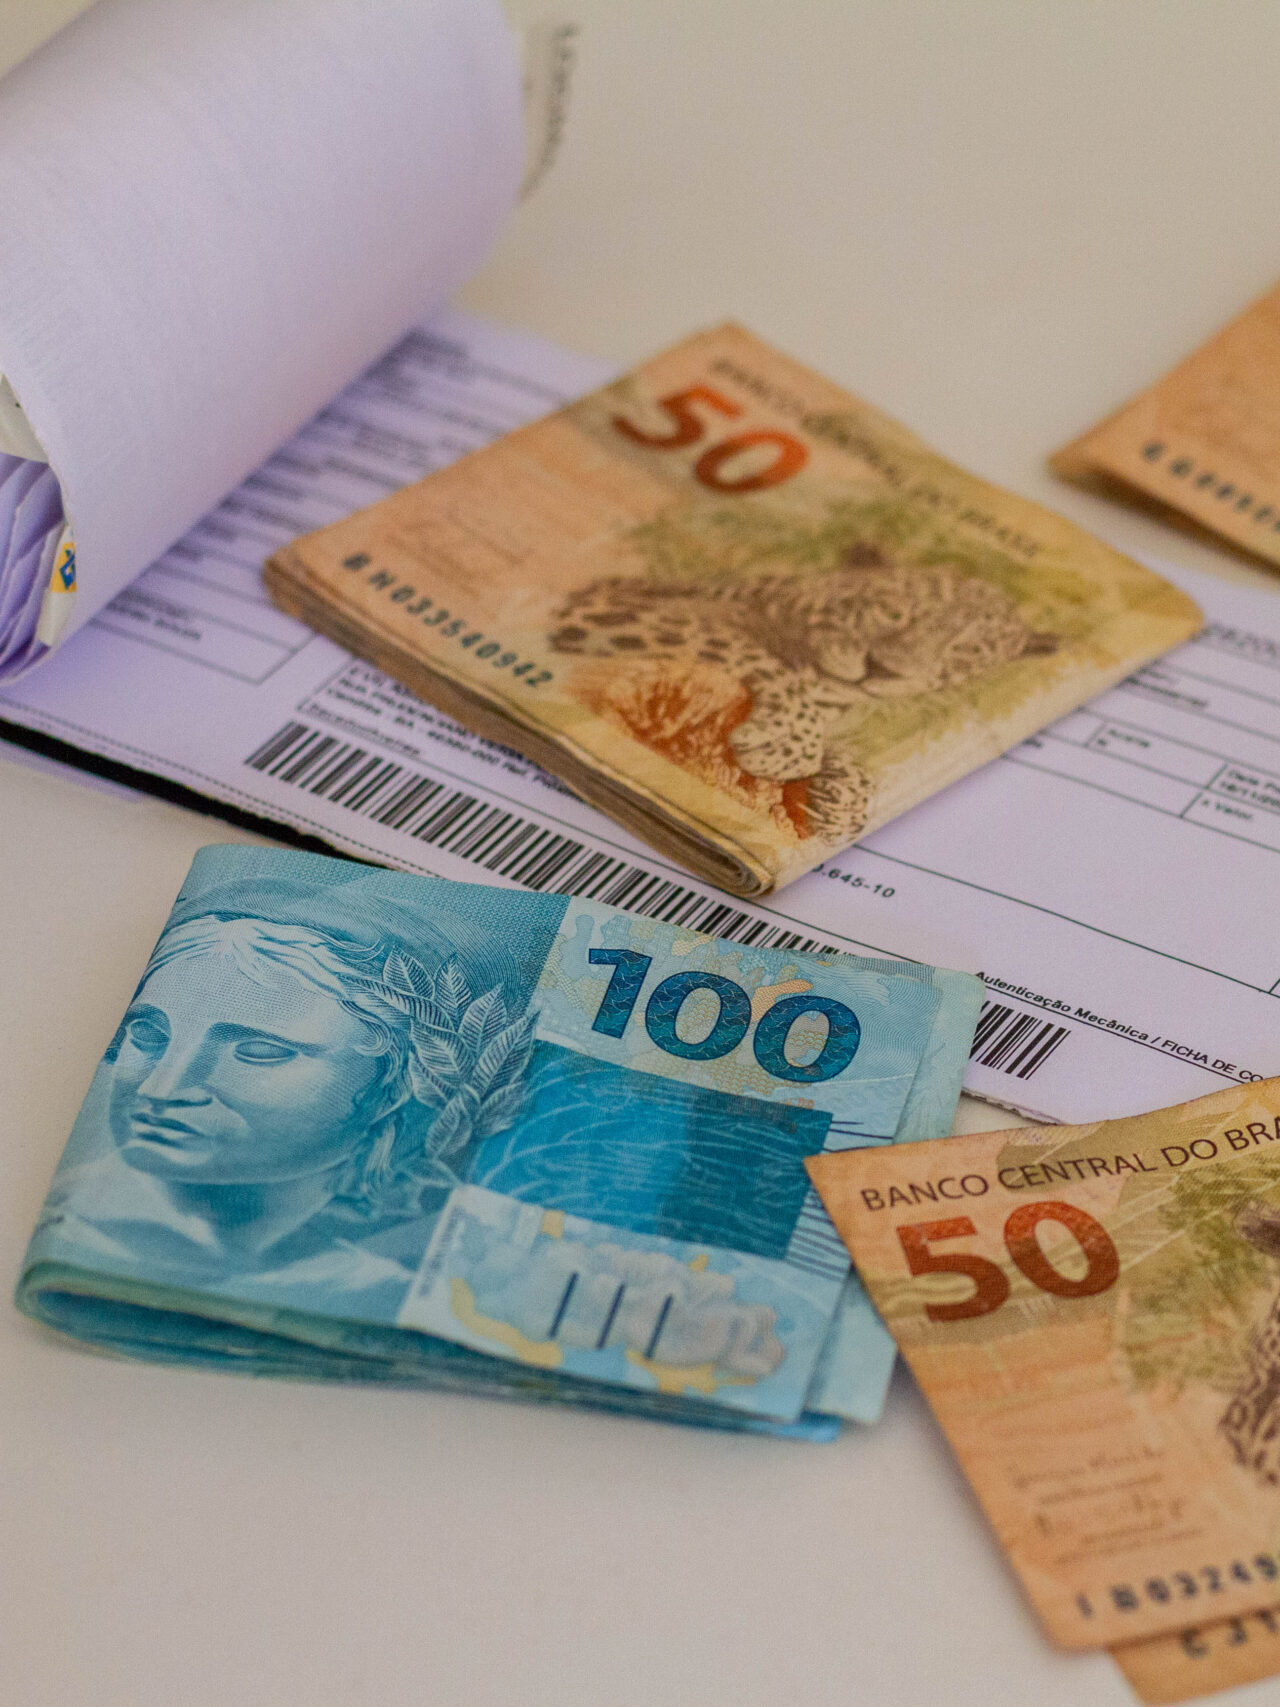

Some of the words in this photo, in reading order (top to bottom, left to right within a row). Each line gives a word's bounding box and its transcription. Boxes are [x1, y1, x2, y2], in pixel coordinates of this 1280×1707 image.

[611, 384, 809, 495] 50
[588, 947, 861, 1083] 100
[974, 970, 1072, 1014] Autenticação
[1073, 1006, 1152, 1042] Mecânica
[1161, 1039, 1209, 1064] FICHA
[1211, 1059, 1237, 1075] DE
[861, 1173, 989, 1212] BANCO
[998, 1152, 1158, 1192] CENTRAL
[1161, 1138, 1218, 1168] DO
[896, 1200, 1120, 1323] 50
